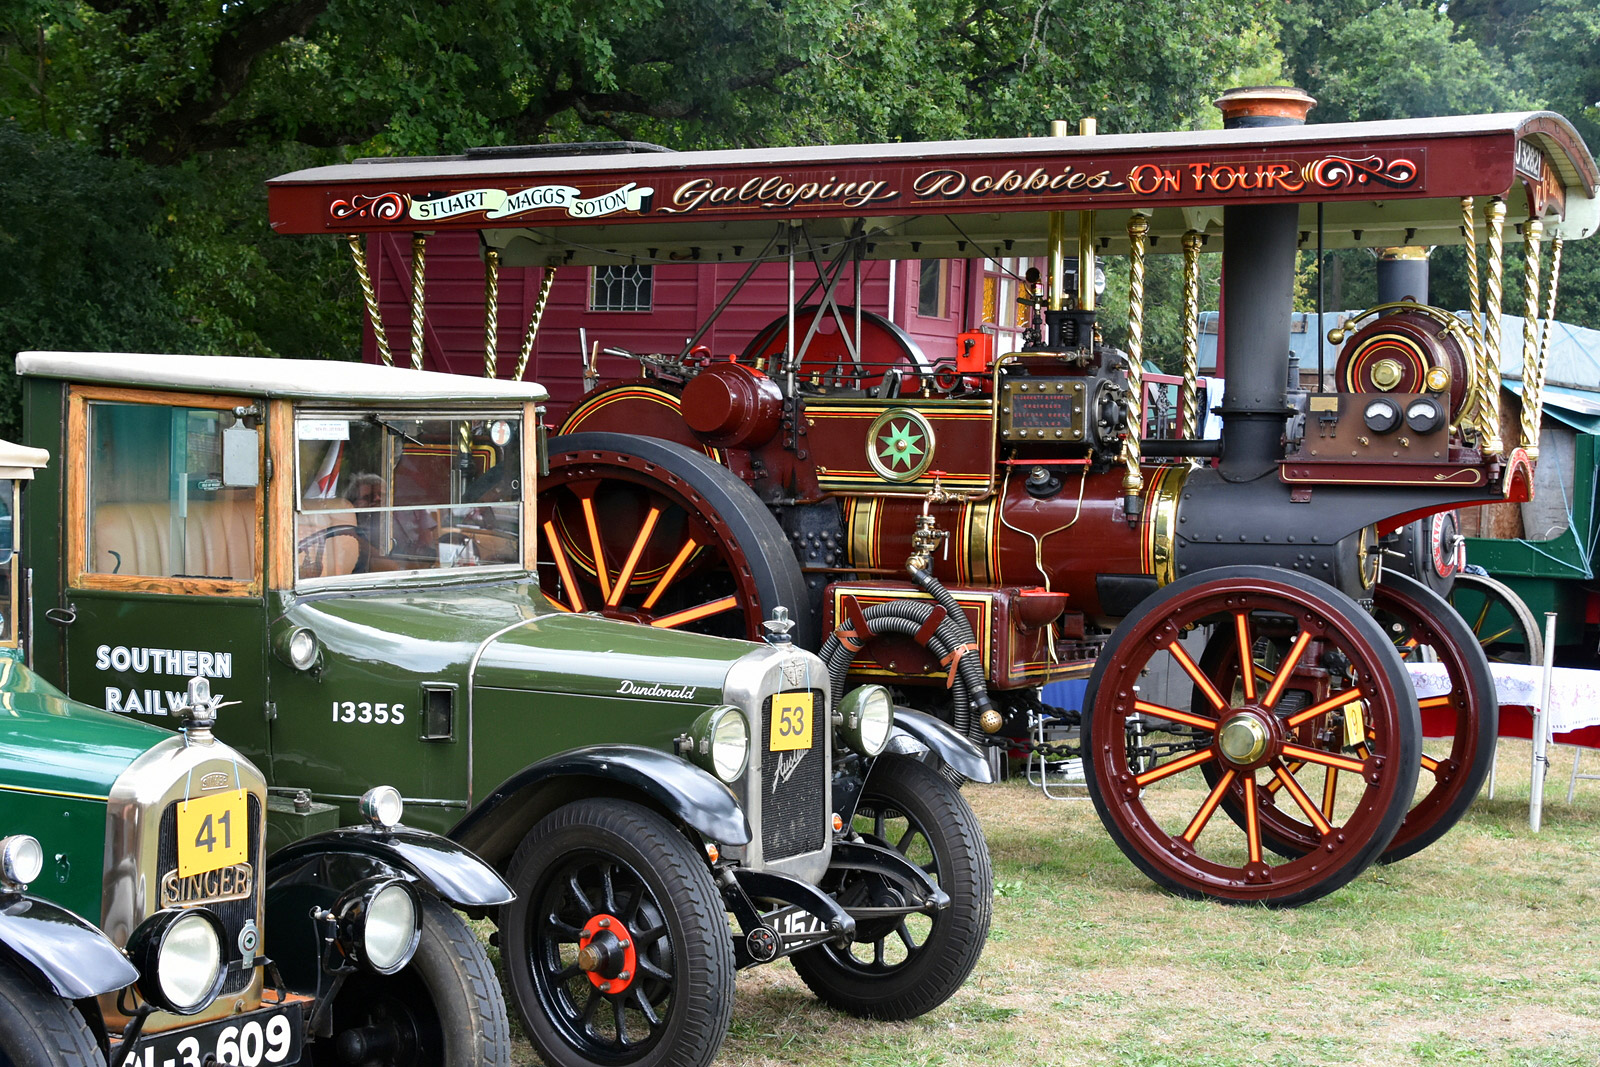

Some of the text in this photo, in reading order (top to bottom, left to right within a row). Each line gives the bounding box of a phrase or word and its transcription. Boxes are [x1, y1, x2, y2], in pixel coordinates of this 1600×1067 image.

[1521, 143, 1538, 175] 3282
[419, 188, 627, 218] STUART MAGGS SOTON
[658, 175, 900, 214] Galloping
[912, 165, 1122, 197] Dobbies
[95, 644, 232, 679] SOUTHERN
[105, 686, 224, 720] RAILWY
[616, 679, 697, 700] Dundonald
[778, 706, 805, 737] 53
[194, 809, 231, 853] 41
[165, 861, 248, 902] SINGER
[216, 1014, 292, 1067] 609
